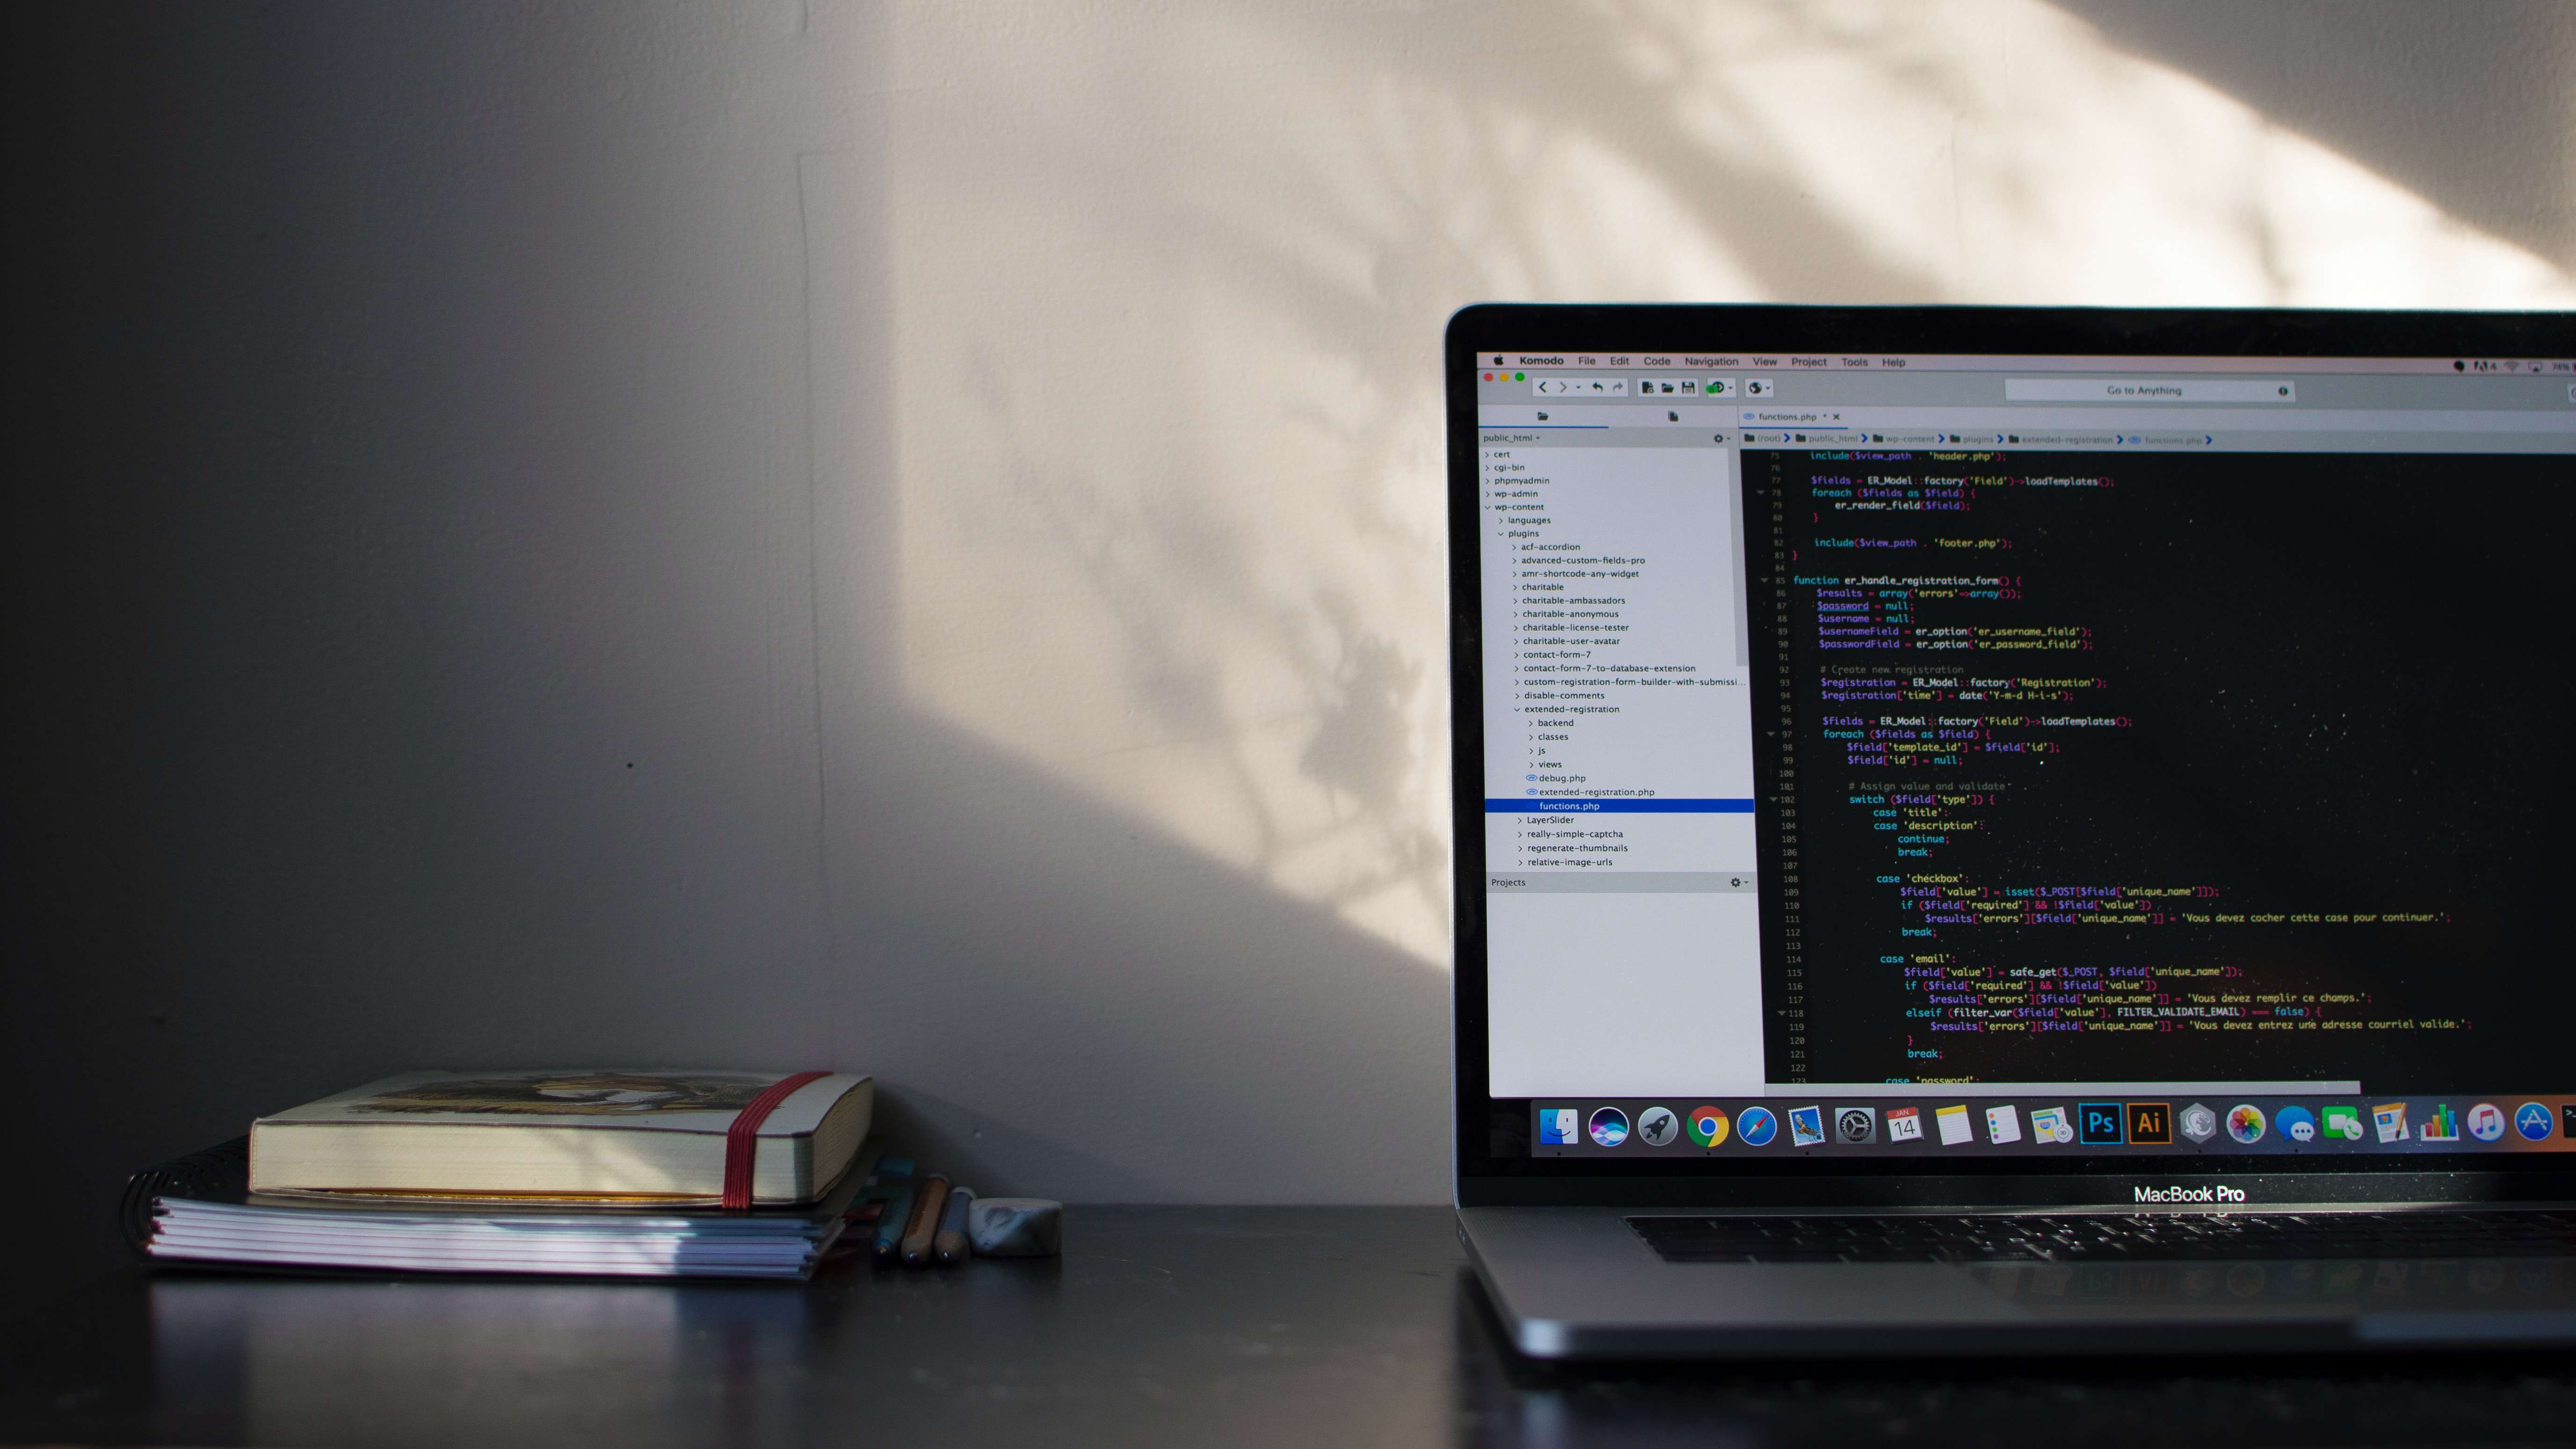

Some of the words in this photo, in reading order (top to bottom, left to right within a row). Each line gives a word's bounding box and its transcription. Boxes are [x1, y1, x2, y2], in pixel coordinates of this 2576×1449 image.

[1611, 357, 1629, 365] Edit
[1644, 357, 1671, 365] Code
[1685, 357, 1738, 367] Navigation
[1792, 358, 1827, 367] Project
[1842, 358, 1868, 366] Tools
[1883, 359, 1905, 367] Help
[2107, 386, 2121, 394] Go
[2138, 387, 2182, 397] Anything
[1759, 413, 1816, 421] functions.php
[1812, 476, 1850, 485] $fields
[1858, 489, 1902, 497] ($fields
[1925, 489, 1964, 497] $field)
[1836, 501, 1969, 510] er_render_field($field);
[1509, 517, 1551, 525] languages
[1522, 557, 1645, 565] advanced-custom-fields-pro
[1522, 570, 1639, 579] amr-shortcode-any-widget
[1817, 589, 1862, 597] $results
[1818, 601, 1869, 611] $password
[1886, 601, 1913, 611] null;
[1523, 610, 1618, 619] charitable-anonymous
[1819, 614, 1869, 623] $username
[1887, 614, 1914, 623] null;
[1819, 627, 1899, 635] $usernameField
[1820, 640, 1899, 649] $passwordField
[1832, 666, 1865, 675] Create
[1895, 665, 1963, 675] registration
[1821, 678, 1895, 688] $registration
[1525, 706, 1619, 714] extended-registration
[1823, 717, 1863, 725] $fields
[1824, 730, 1864, 738] foreach
[1871, 730, 1916, 739] ($fields
[1939, 730, 1979, 739] $field)
[1934, 756, 1962, 765] null;
[1539, 775, 1586, 783] debug.php
[1861, 782, 1895, 792] Assign
[1539, 789, 1654, 797] extended-registration.php
[1540, 802, 1599, 811] functions.php
[1528, 816, 1574, 825] LayerSlider
[1528, 830, 1623, 839] really-simple-captcha
[1898, 834, 1949, 844] continue;
[1528, 844, 1628, 853] regenerate-thumbnails
[1898, 848, 1932, 857] break;
[1529, 858, 1612, 867] relative-image-urls
[1902, 900, 1912, 909] if
[2216, 913, 2244, 922] devez
[2250, 913, 2285, 922] cocher
[1902, 928, 1936, 937] break;
[1906, 981, 1916, 990] if
[2221, 994, 2250, 1002] devez
[2257, 993, 2297, 1003] remplir
[1907, 1008, 1941, 1017] elseif
[2276, 1007, 2309, 1016] false)
[2224, 1021, 2252, 1029] devez
[2369, 1020, 2414, 1029] courriel
[1908, 1049, 1942, 1059] break;
[2089, 1112, 2113, 1132] Ps
[2138, 1112, 2159, 1132] Ai
[1894, 1120, 1915, 1136] 14
[2134, 1186, 2213, 1202] MacBook
[2217, 1185, 2245, 1202] Pro
